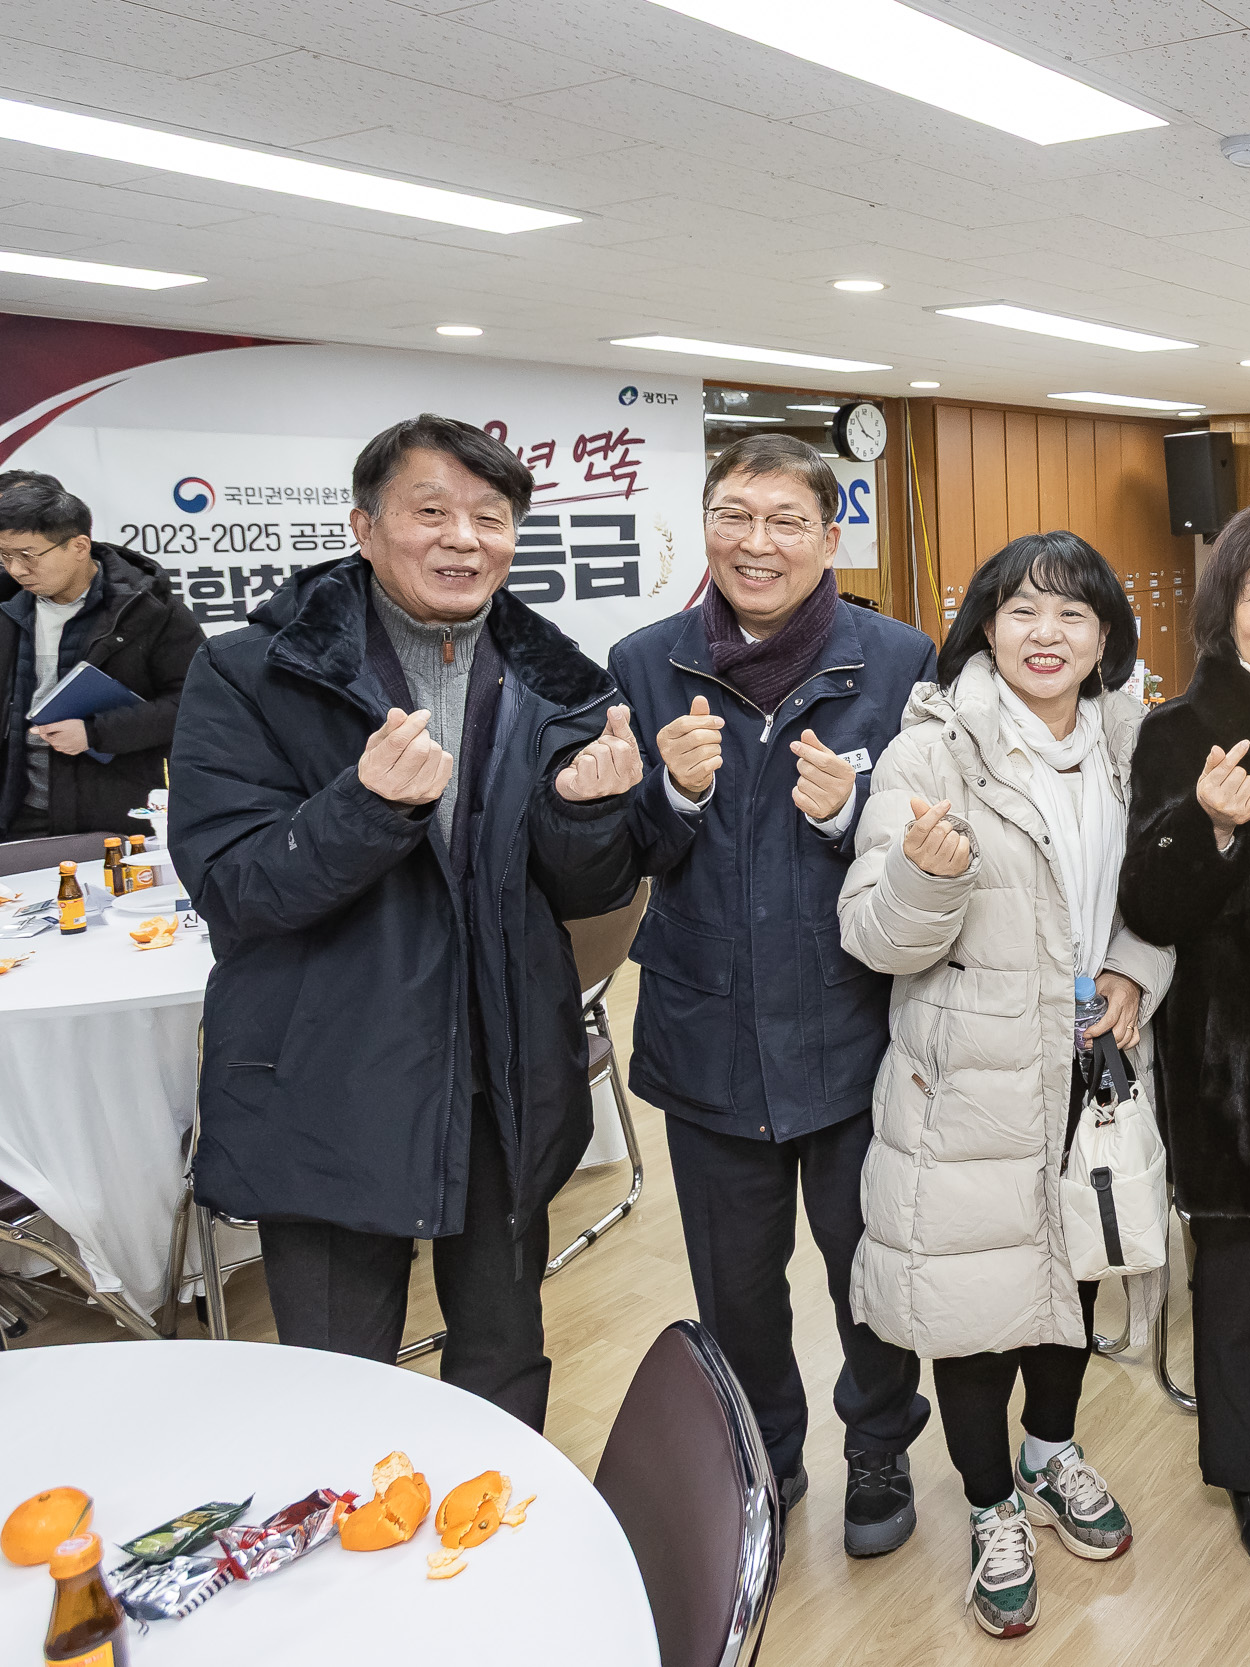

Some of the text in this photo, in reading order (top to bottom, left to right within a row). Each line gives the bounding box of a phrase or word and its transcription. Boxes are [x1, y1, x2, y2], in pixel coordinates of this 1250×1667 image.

[642, 391, 679, 405] 광진구
[573, 427, 646, 500] 연속
[120, 522, 357, 554] 2023-2025 공공
